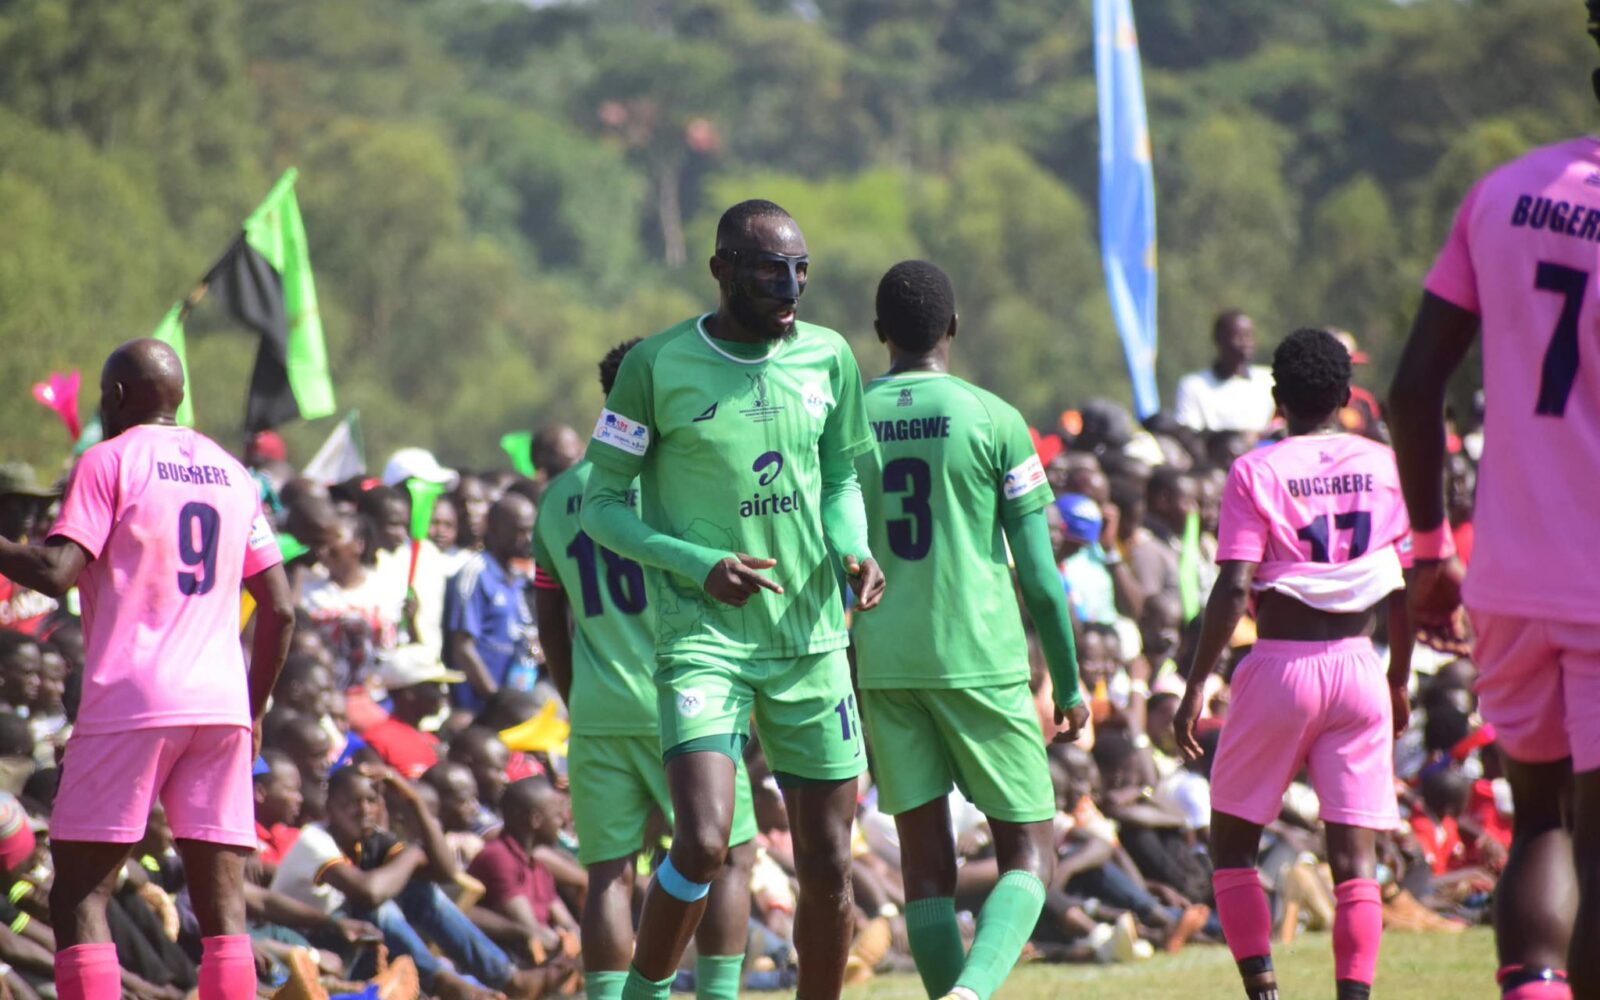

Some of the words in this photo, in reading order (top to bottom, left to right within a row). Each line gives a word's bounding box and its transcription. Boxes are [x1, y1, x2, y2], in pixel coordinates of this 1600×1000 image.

[1510, 194, 1600, 243] BUGER
[1534, 261, 1588, 418] 7
[871, 416, 951, 443] YAGGWE
[740, 490, 799, 517] airtel
[883, 457, 932, 561] 3
[178, 502, 221, 596] 9
[1297, 511, 1371, 563] 17
